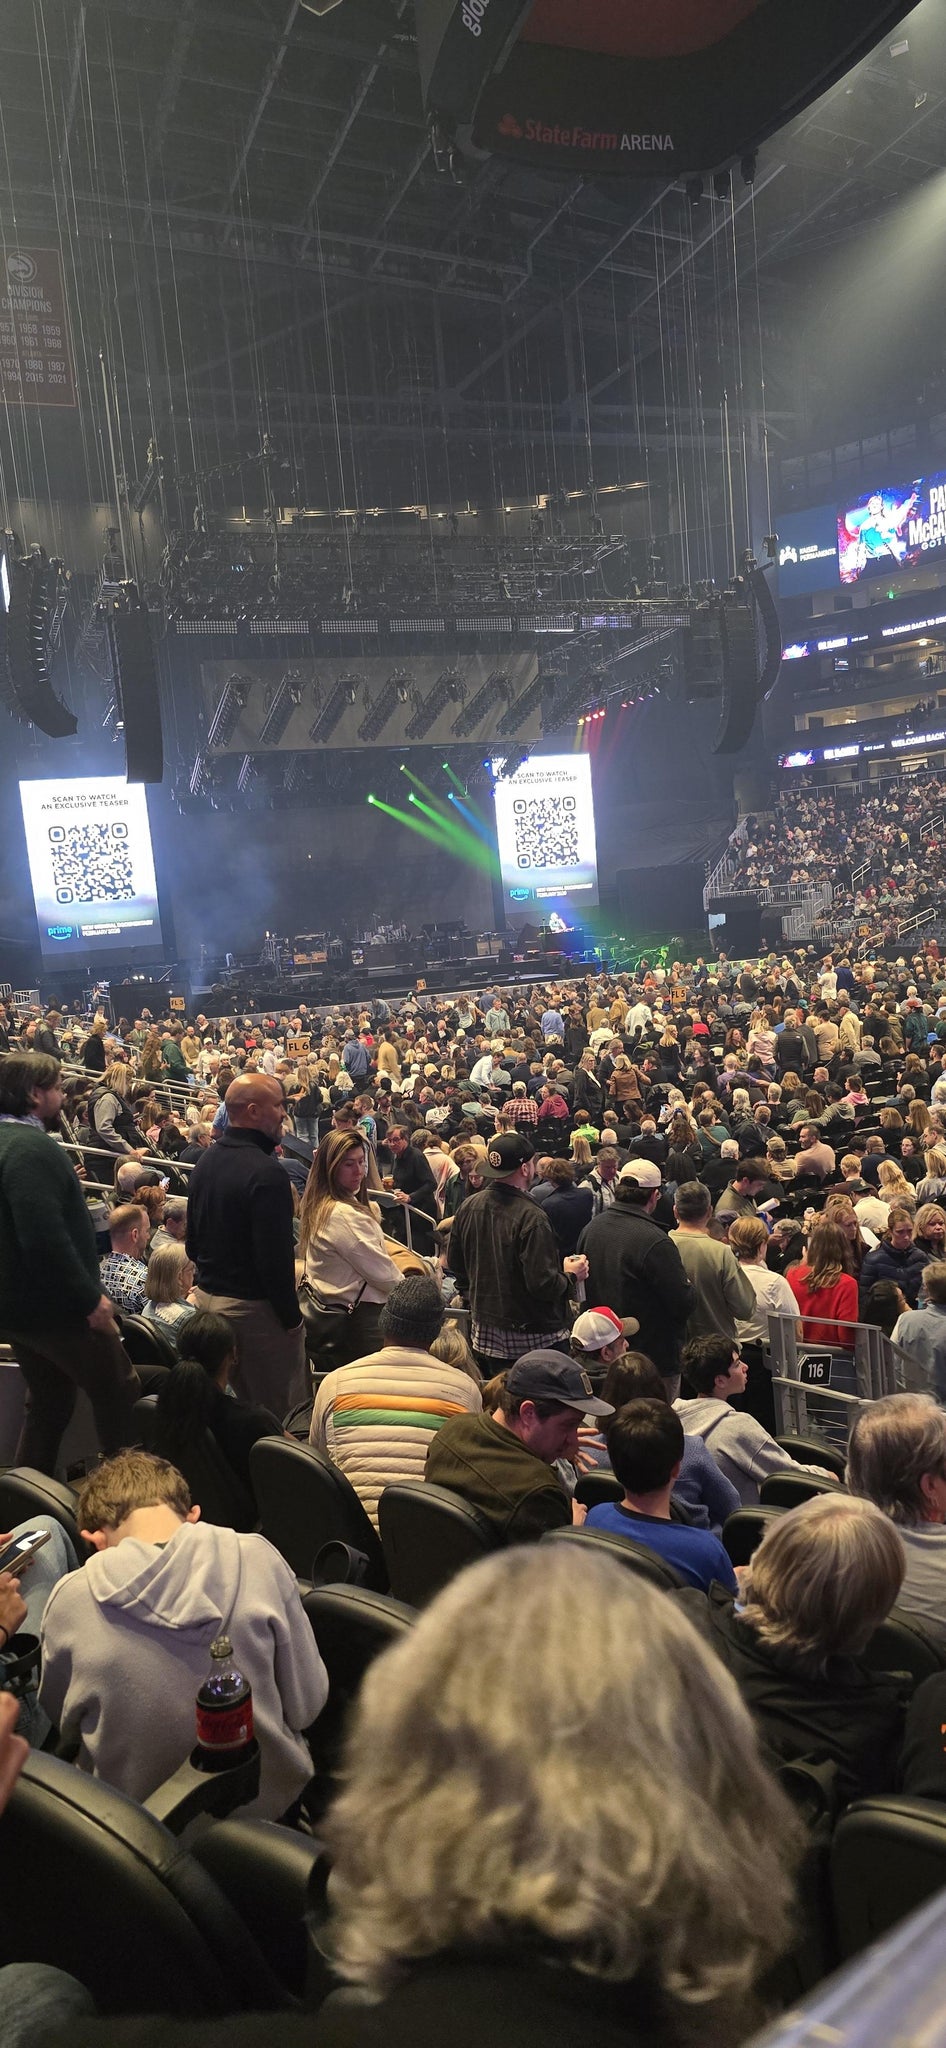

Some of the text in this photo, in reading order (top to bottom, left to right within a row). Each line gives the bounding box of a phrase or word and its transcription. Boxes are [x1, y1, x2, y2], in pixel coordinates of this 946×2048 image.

[620, 134, 674, 151] ARENA
[1, 298, 52, 312] CHAMPIONS
[0, 322, 61, 336] 957 1958 1959
[21, 336, 39, 346] 1961
[1, 358, 66, 372] 1970 1980 1987
[25, 372, 44, 383] 2015
[48, 374, 66, 384] 2021
[882, 624, 911, 636] WELCOME
[911, 620, 927, 630] BACK
[891, 731, 945, 747] WELCOME BACK
[54, 801, 97, 810] EXCLUSIVE
[47, 925, 73, 937] prime
[288, 1041, 309, 1051] FL 6
[434, 1108, 447, 1116] PAU
[807, 1363, 824, 1378] 116
